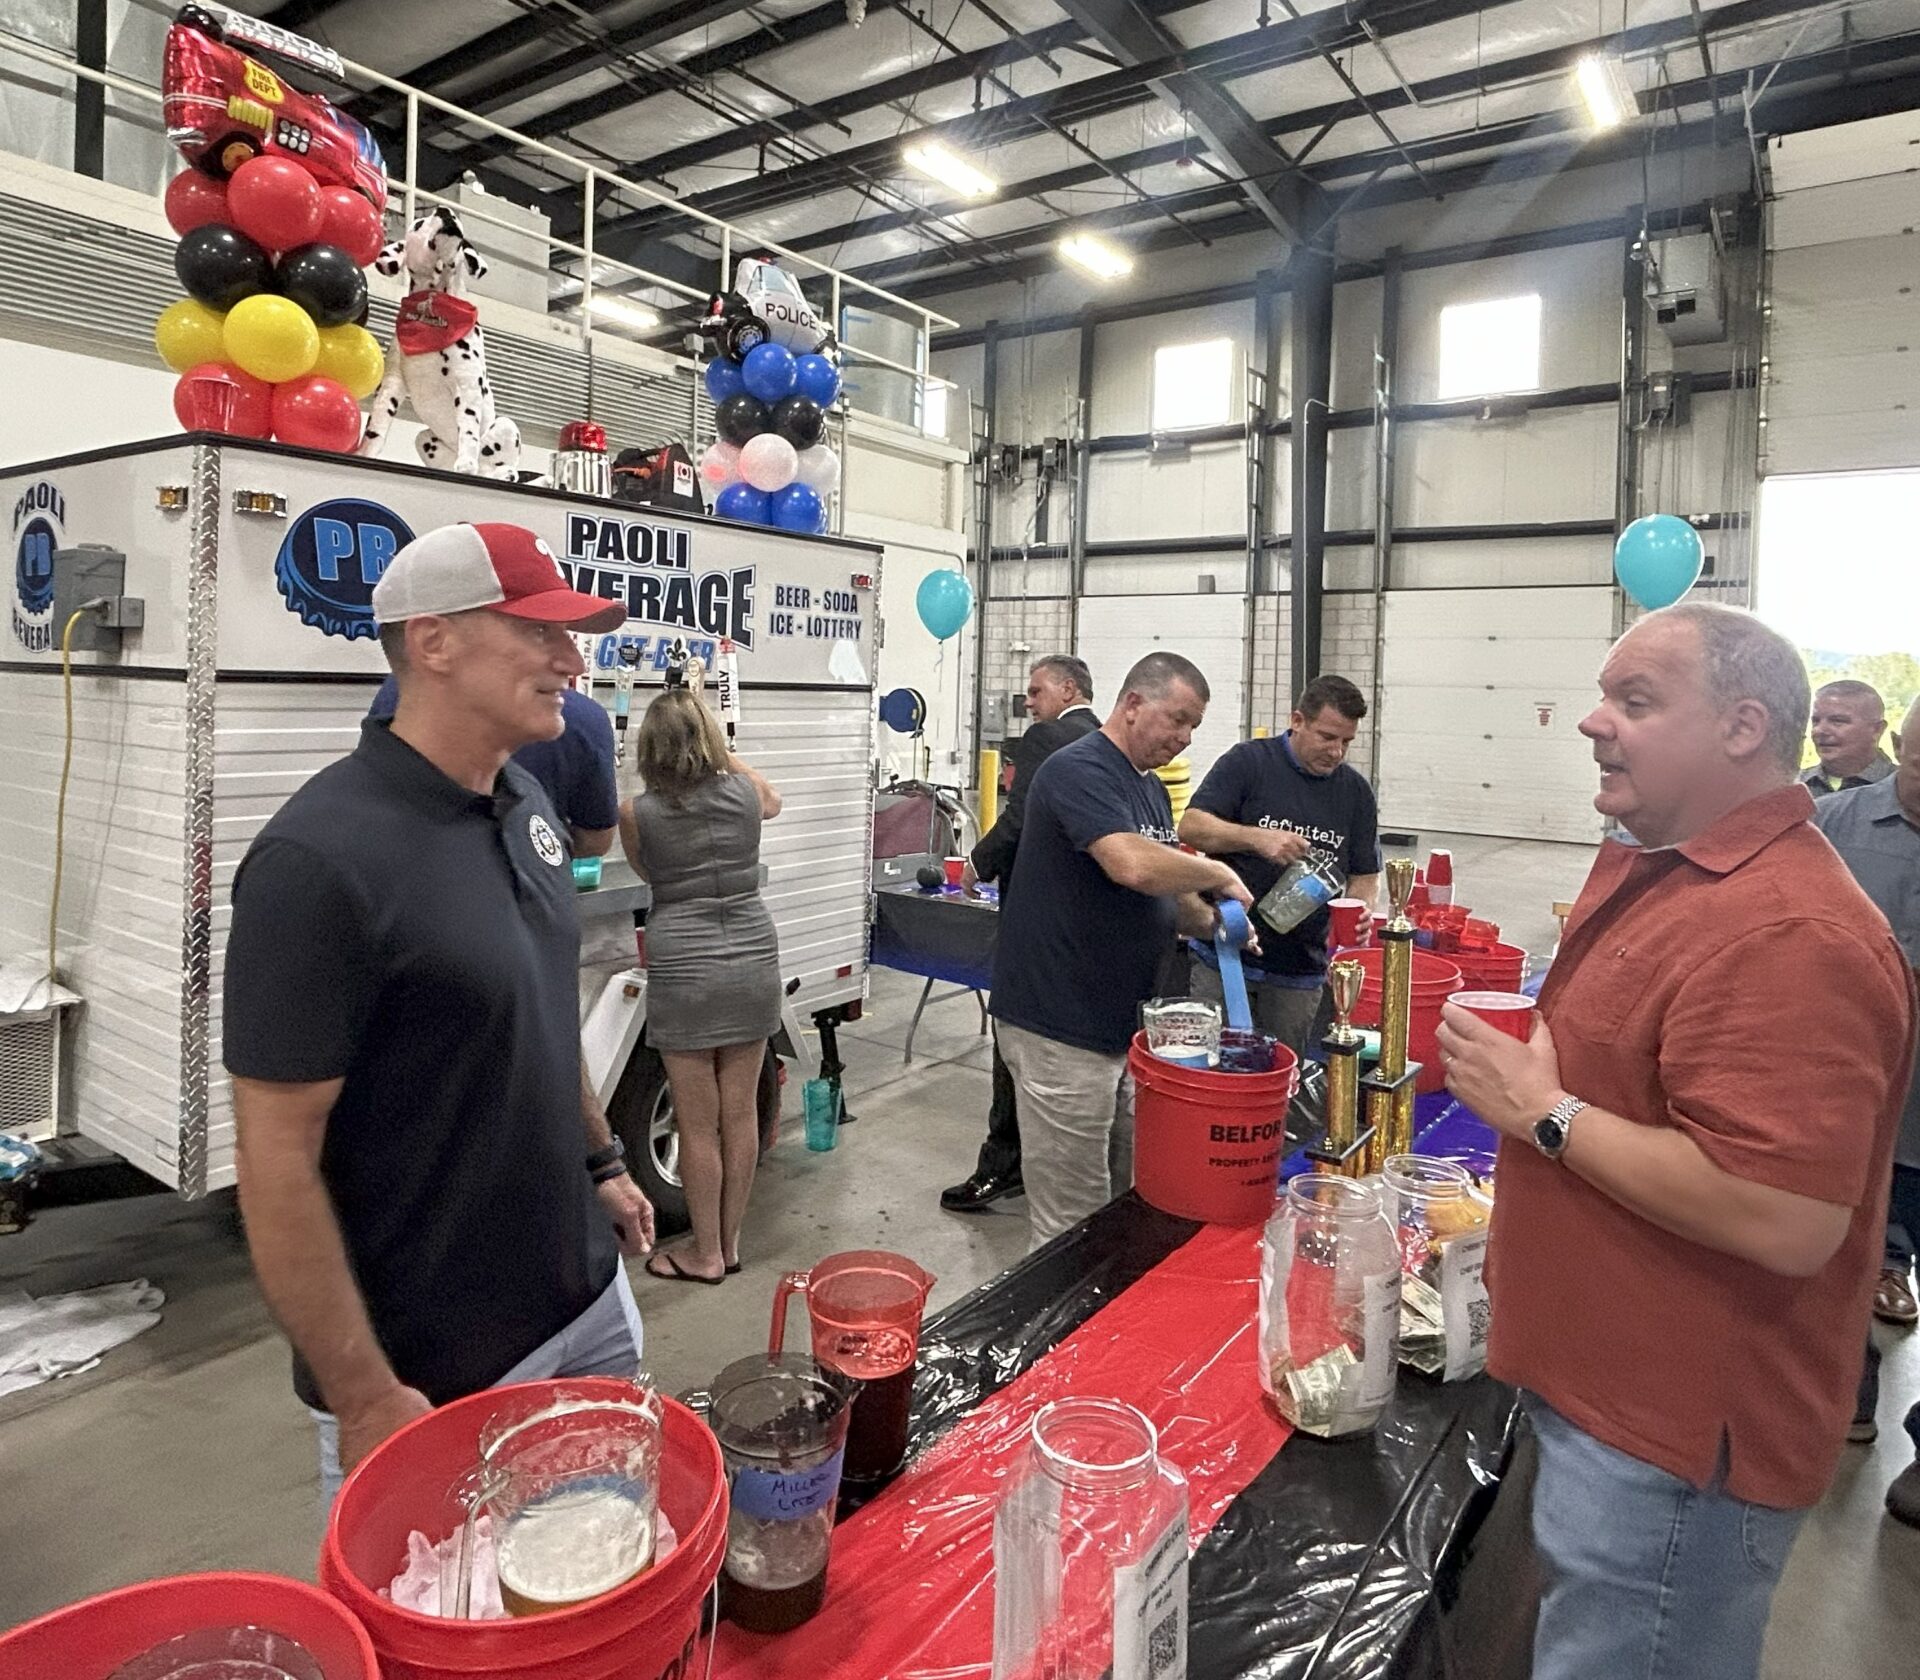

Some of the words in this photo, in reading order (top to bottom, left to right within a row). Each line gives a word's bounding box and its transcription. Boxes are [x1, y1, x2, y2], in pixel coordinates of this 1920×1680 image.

[252, 78, 277, 98] DEPT
[765, 303, 818, 331] POLICE
[13, 482, 65, 532] PAOLI
[314, 517, 397, 585] PB
[567, 512, 691, 572] PAOLI
[557, 561, 756, 651] VERAGE
[775, 585, 811, 609] BEER
[823, 590, 859, 614] SODA
[12, 607, 50, 651] BEVERA
[769, 613, 794, 635] ICE
[806, 616, 863, 640] LOTTERY
[595, 633, 716, 673] GET-BER
[719, 669, 732, 712] TRULY
[1258, 814, 1345, 849] definitely
